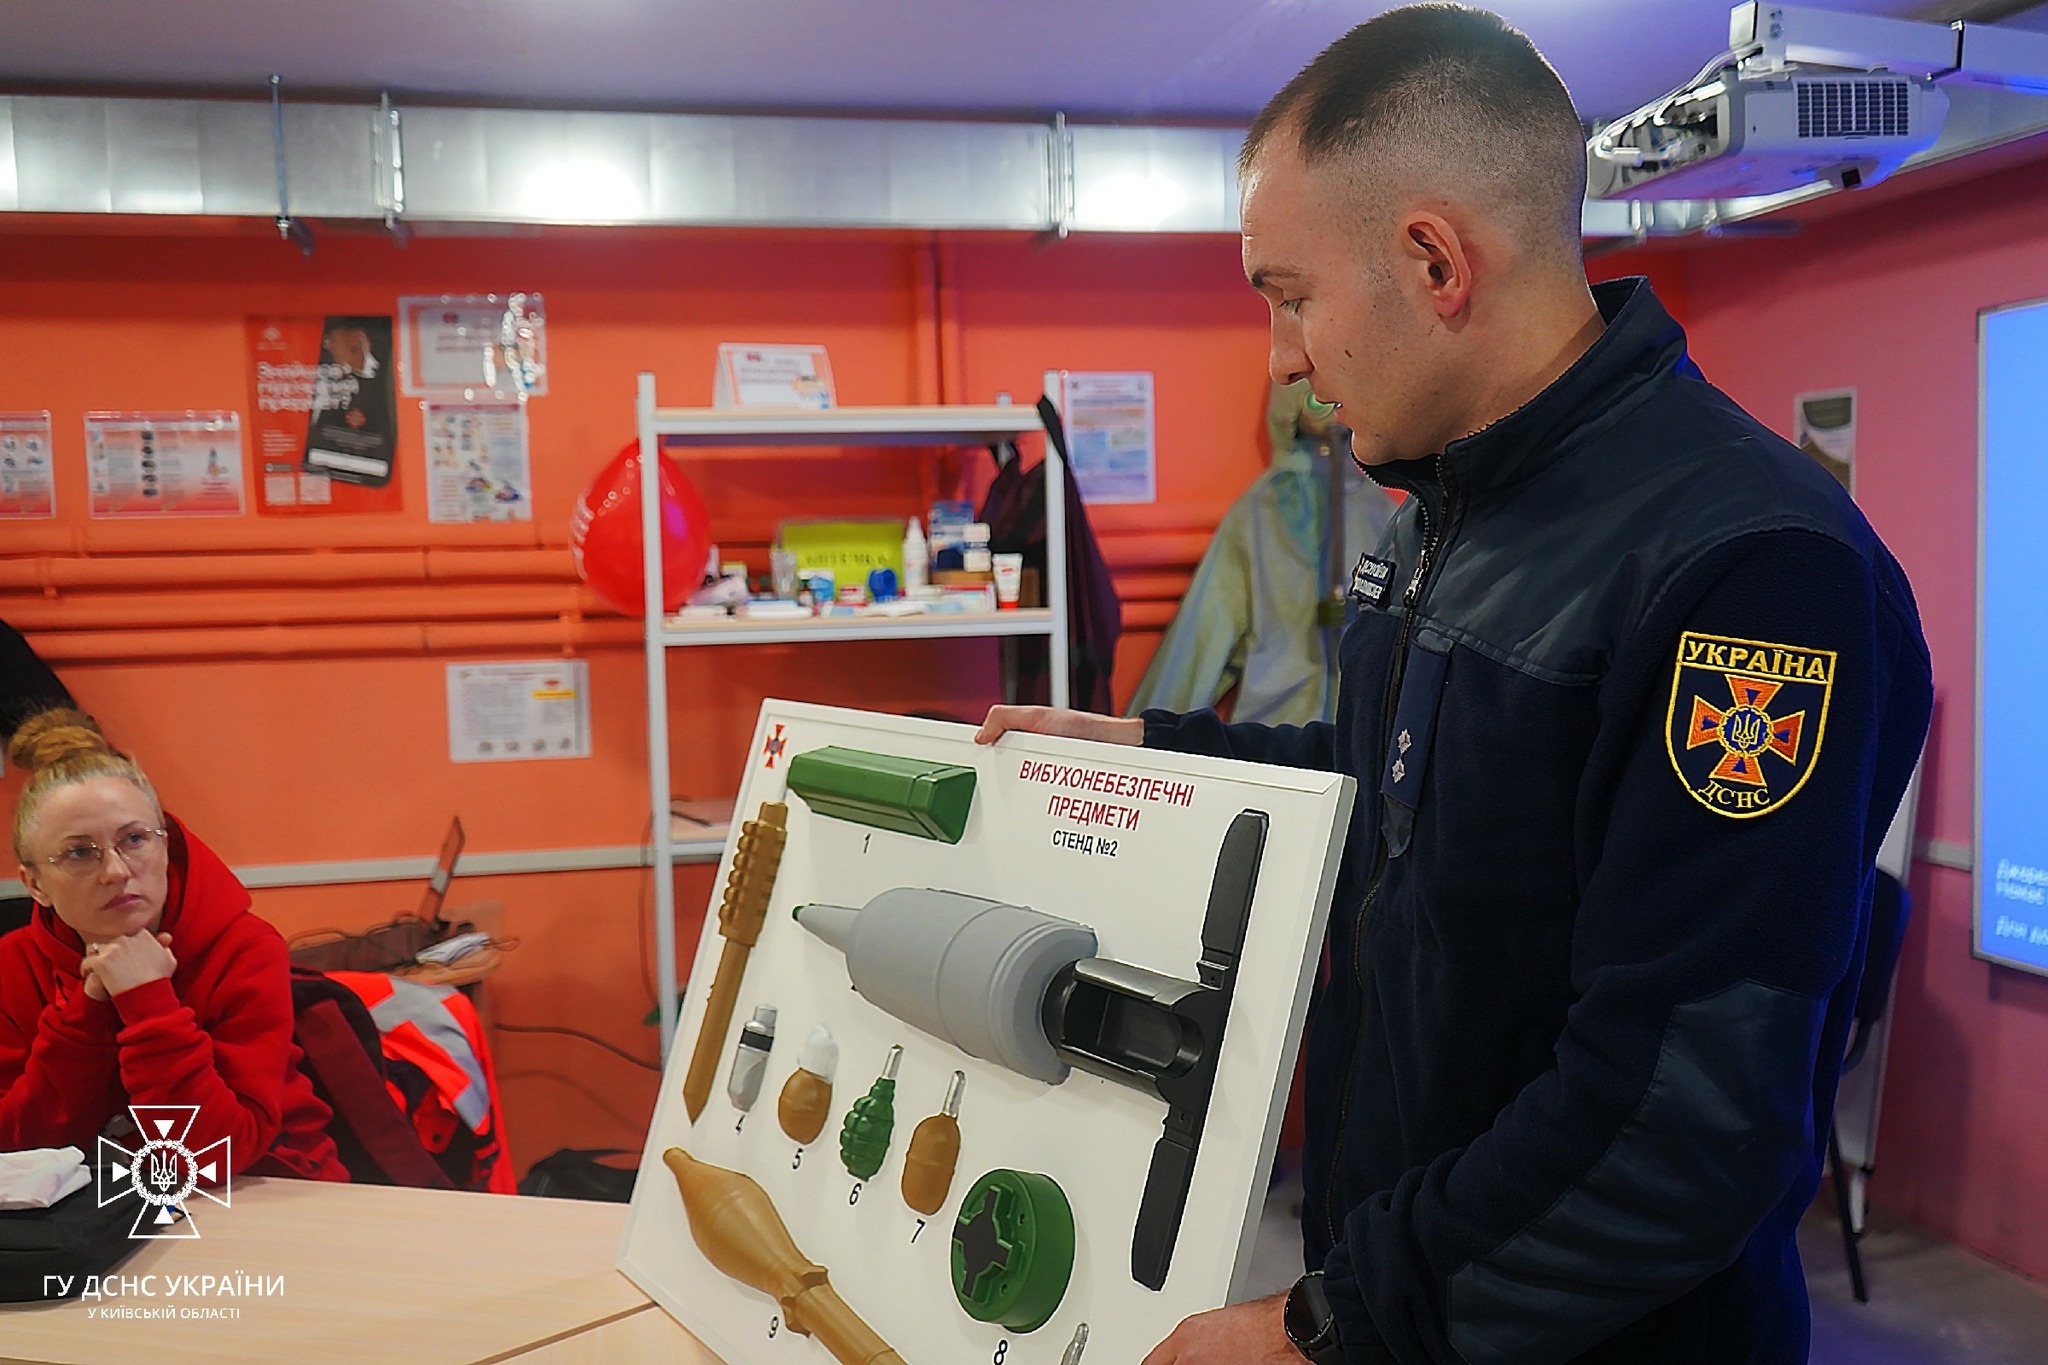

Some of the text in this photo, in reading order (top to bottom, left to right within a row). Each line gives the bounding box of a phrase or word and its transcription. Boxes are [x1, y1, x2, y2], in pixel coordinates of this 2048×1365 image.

[1685, 640, 1826, 681] УКРАЇНА
[1019, 760, 1195, 807] ВИБУХОНЕБЕЗПЕЧНІ
[1698, 780, 1770, 808] ДСНС
[1047, 795, 1140, 831] ПРЕДМЕТИ
[863, 833, 872, 854] 1
[1052, 830, 1118, 857] СТЕНД №2
[792, 1148, 803, 1170] 5
[849, 1182, 862, 1205] 6
[911, 1218, 926, 1243] 7
[768, 1316, 778, 1338] 9
[994, 1339, 1008, 1365] 8
